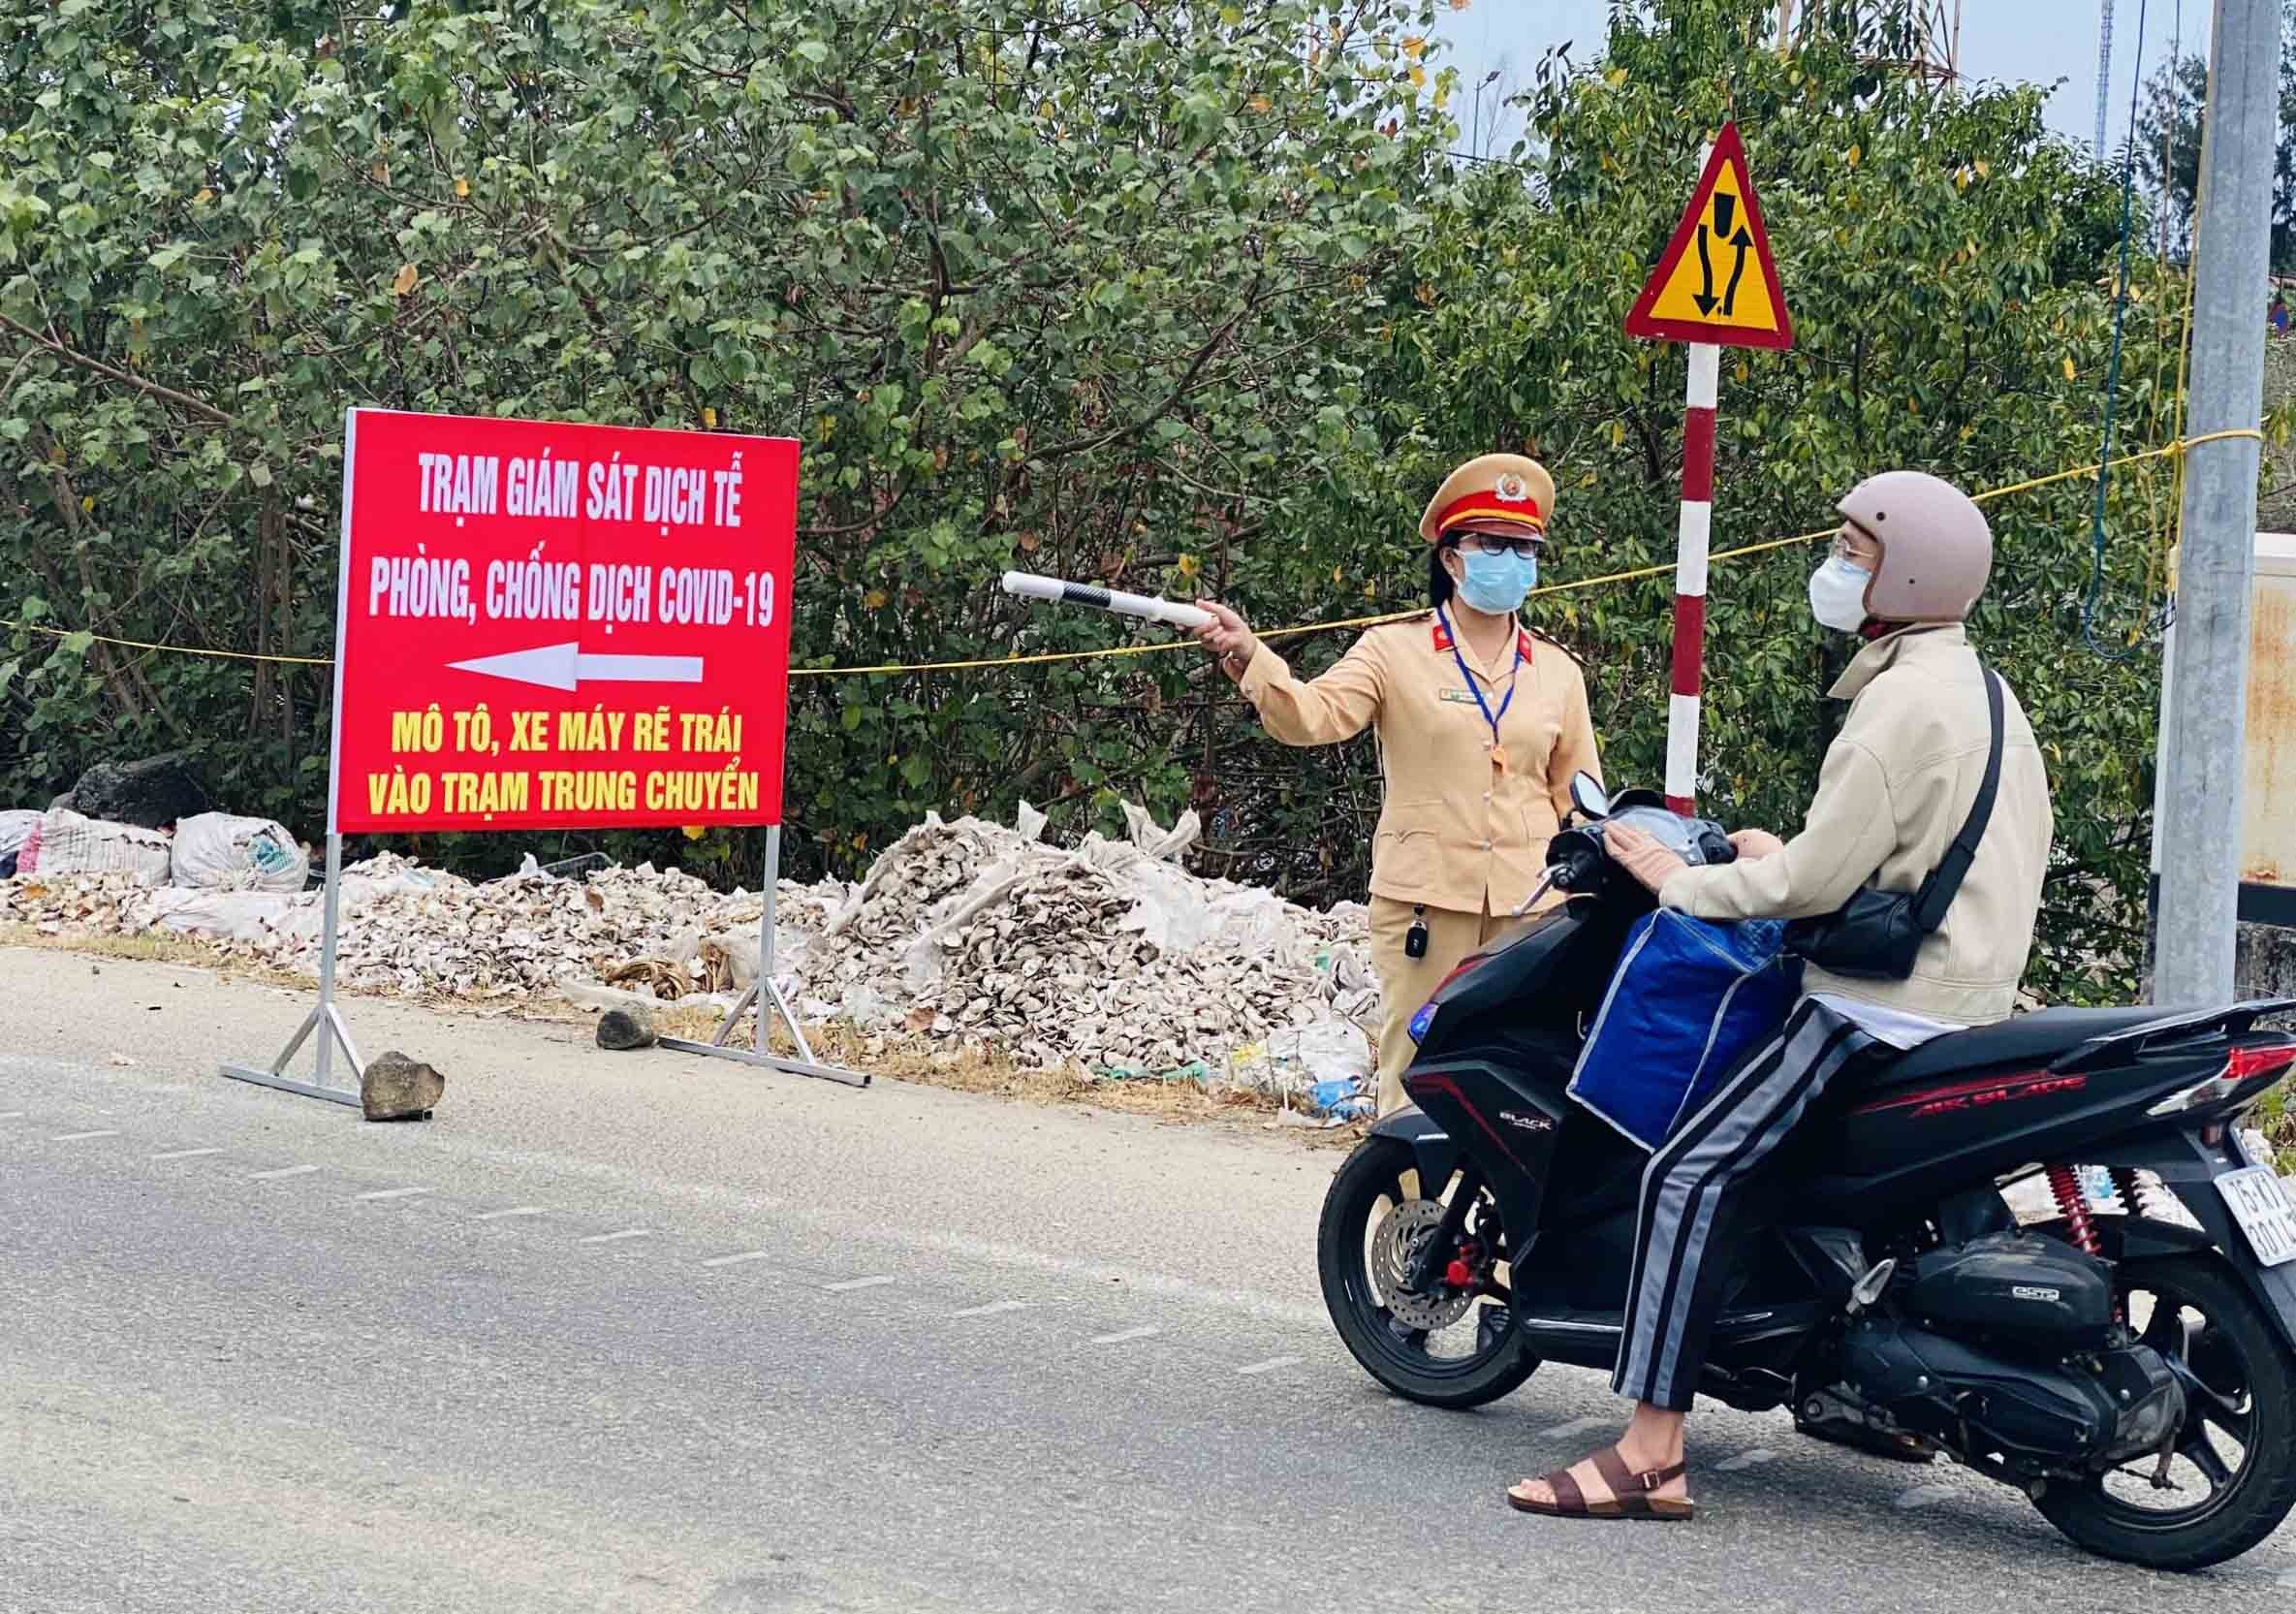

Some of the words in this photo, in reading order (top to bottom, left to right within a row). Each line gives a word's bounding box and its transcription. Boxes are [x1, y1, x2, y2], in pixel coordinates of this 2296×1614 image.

[419, 453, 498, 526] TRẠM
[507, 447, 579, 518] GIÁM
[586, 452, 638, 521] SÁT
[644, 466, 706, 535] DỊCH
[713, 452, 742, 527] TỄ
[369, 543, 476, 625] PHÒNG,
[487, 541, 581, 620] CHỐNG
[588, 564, 651, 634] DỊCH
[659, 566, 773, 626] COVID-19
[392, 703, 443, 752] MÔ
[454, 703, 499, 756] TÔ,
[510, 712, 550, 751] XE
[558, 704, 625, 751] MÁY
[634, 706, 670, 751] RẼ
[679, 706, 741, 752] TRÁI
[368, 765, 430, 814] VÀO
[441, 772, 529, 821] TRẠM
[539, 771, 636, 810] TRUNG
[645, 756, 758, 810] CHUYỂN
[1498, 1111, 1551, 1130] BLACK
